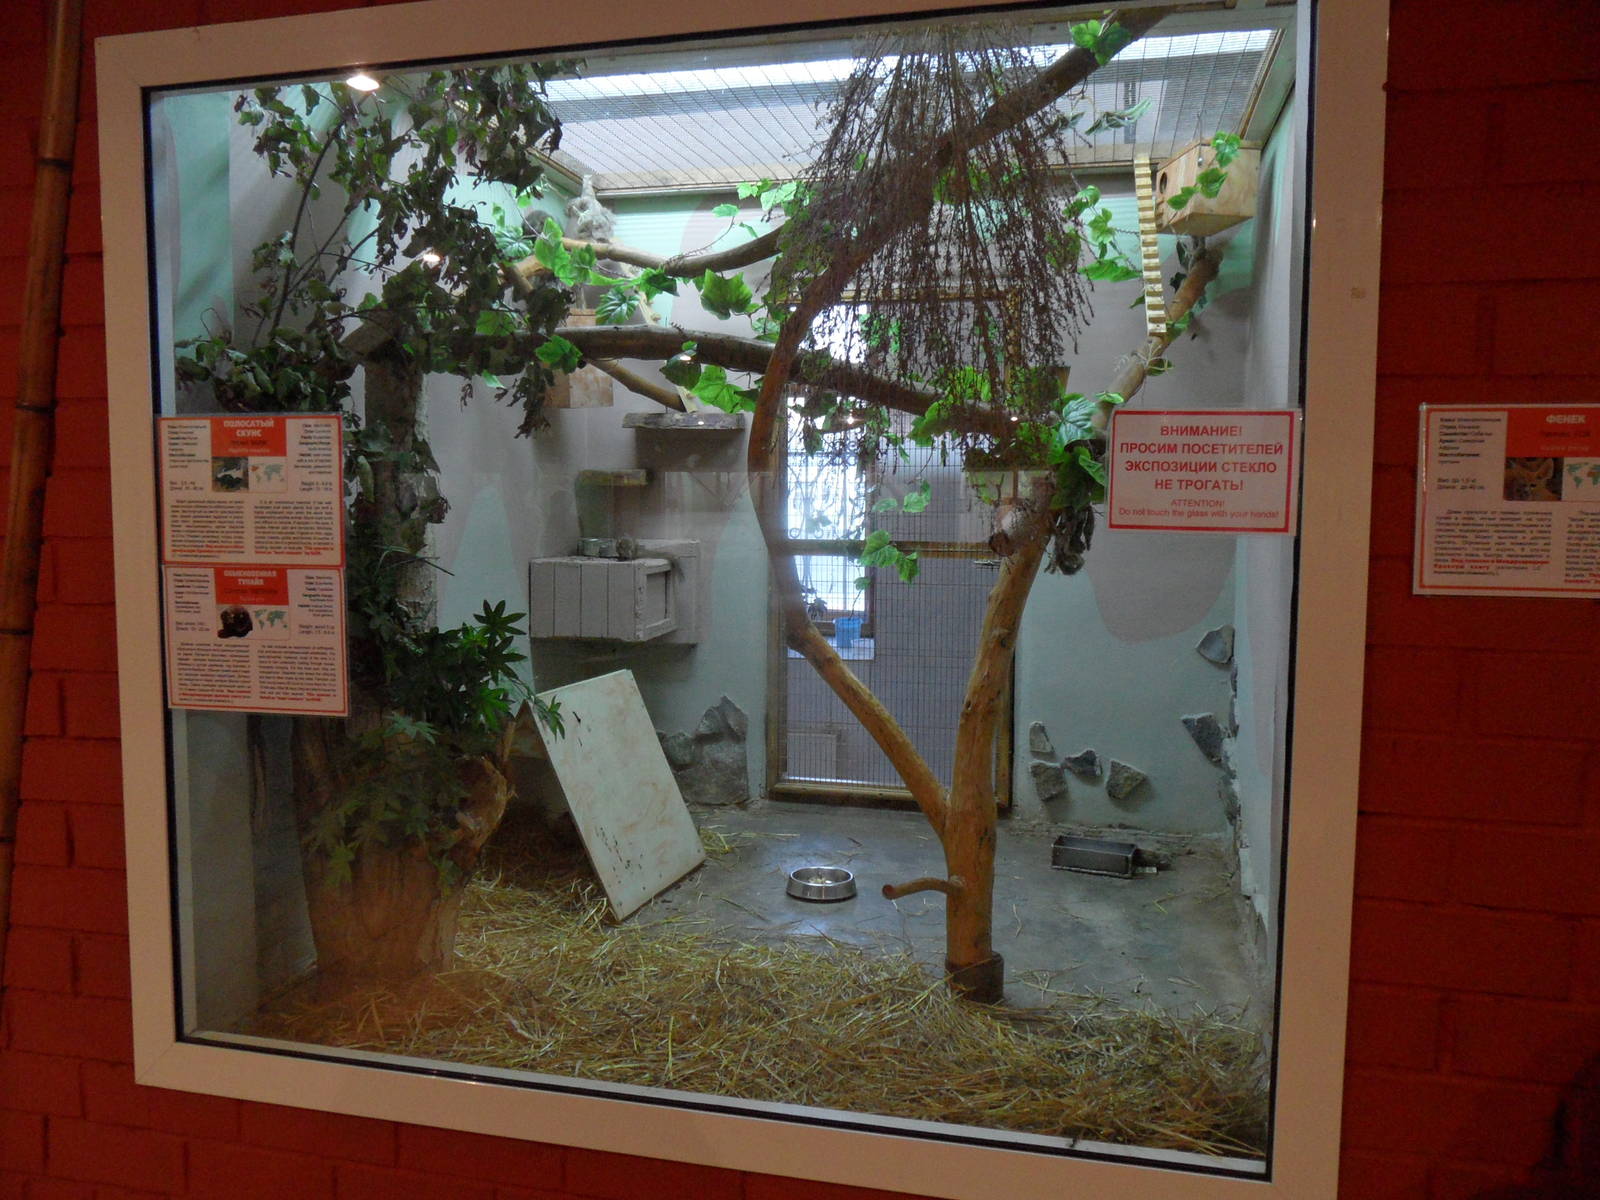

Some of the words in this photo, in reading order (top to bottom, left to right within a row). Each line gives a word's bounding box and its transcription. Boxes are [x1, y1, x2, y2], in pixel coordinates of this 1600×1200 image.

[223, 418, 275, 428] ПОЛОСАТЫЙ
[1546, 413, 1587, 425] ФЕНЕК
[235, 429, 263, 438] СКУНС
[1160, 425, 1243, 437] ВНИМАНИЕ!
[1119, 442, 1178, 454] ПРОСИМ
[1181, 441, 1283, 455] ПОСЕТИТЕЛЕЙ
[1125, 460, 1217, 474] ЭКСПОЗИЦИИ
[1221, 461, 1277, 473] СТЕКЛО
[1154, 479, 1173, 490] НЕ
[1176, 479, 1244, 491] ТРОГАТЬ!
[1170, 499, 1226, 508] ATTENTION!
[1119, 508, 1131, 516] Do
[1132, 508, 1146, 516] not
[1147, 508, 1170, 516] touch
[1172, 508, 1185, 517] the
[1187, 509, 1208, 518] glass
[1210, 509, 1228, 518] with
[1229, 510, 1249, 519] your
